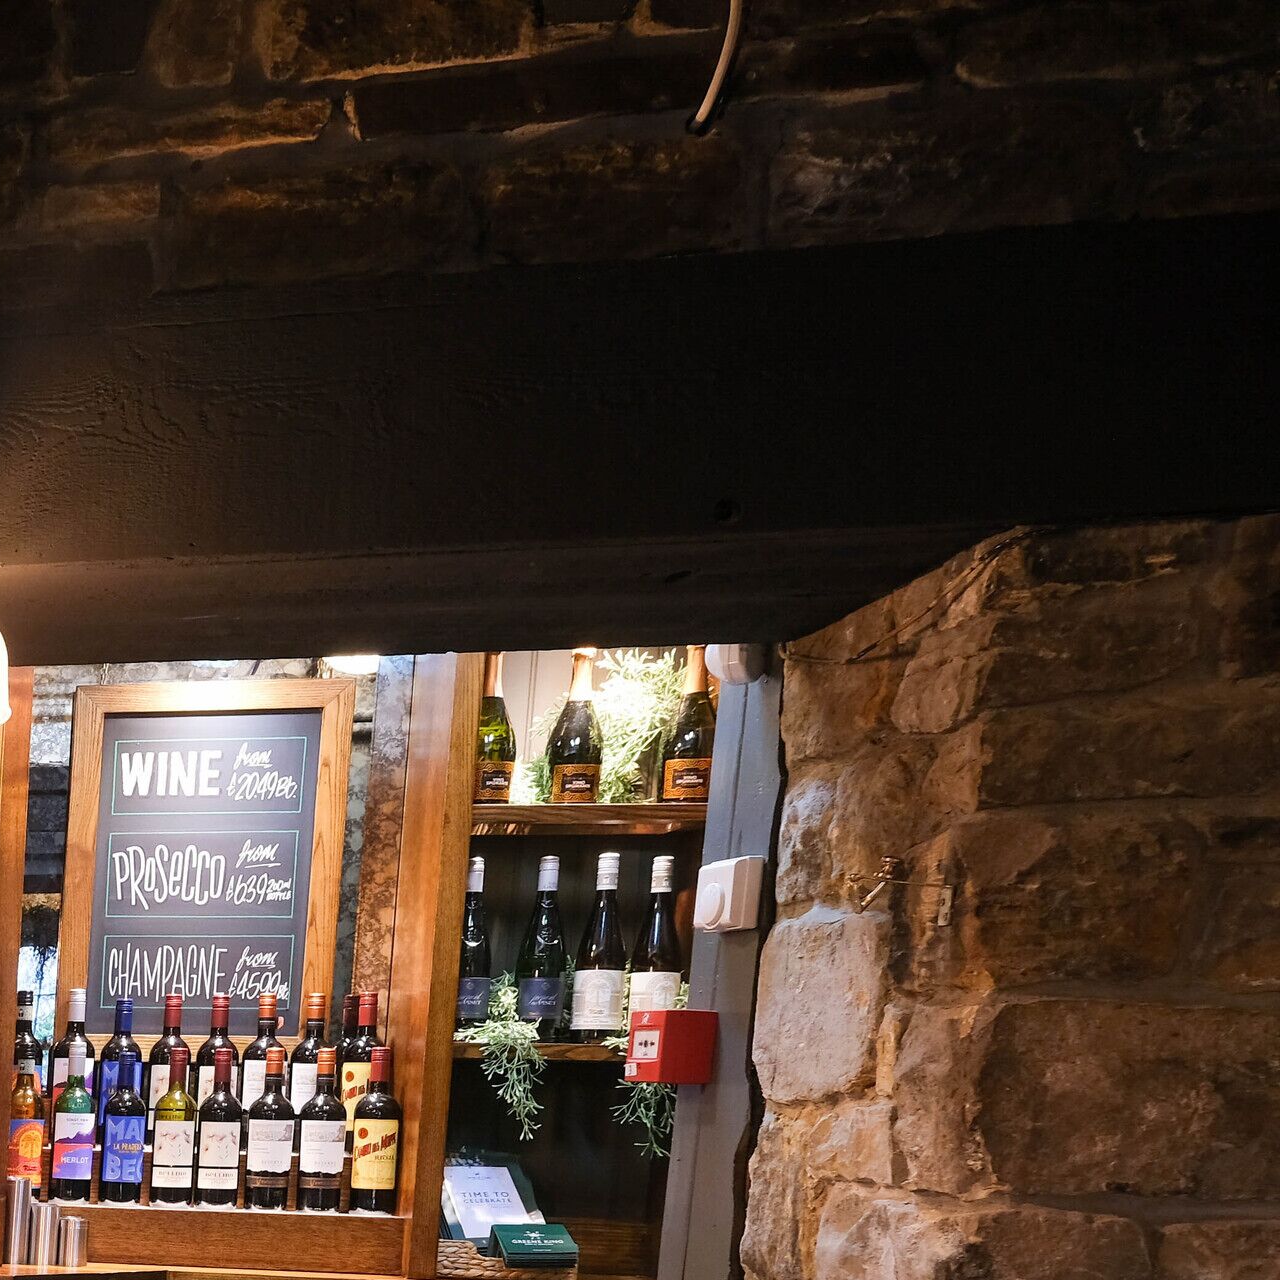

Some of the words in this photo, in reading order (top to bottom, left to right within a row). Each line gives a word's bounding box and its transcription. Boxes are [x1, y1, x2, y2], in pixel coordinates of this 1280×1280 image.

[121, 750, 222, 797] WINE
[233, 742, 273, 770] from
[235, 839, 281, 869] from
[108, 942, 228, 1002] CHAMPAGNE
[235, 945, 278, 972] from
[61, 1156, 89, 1164] MERLOT
